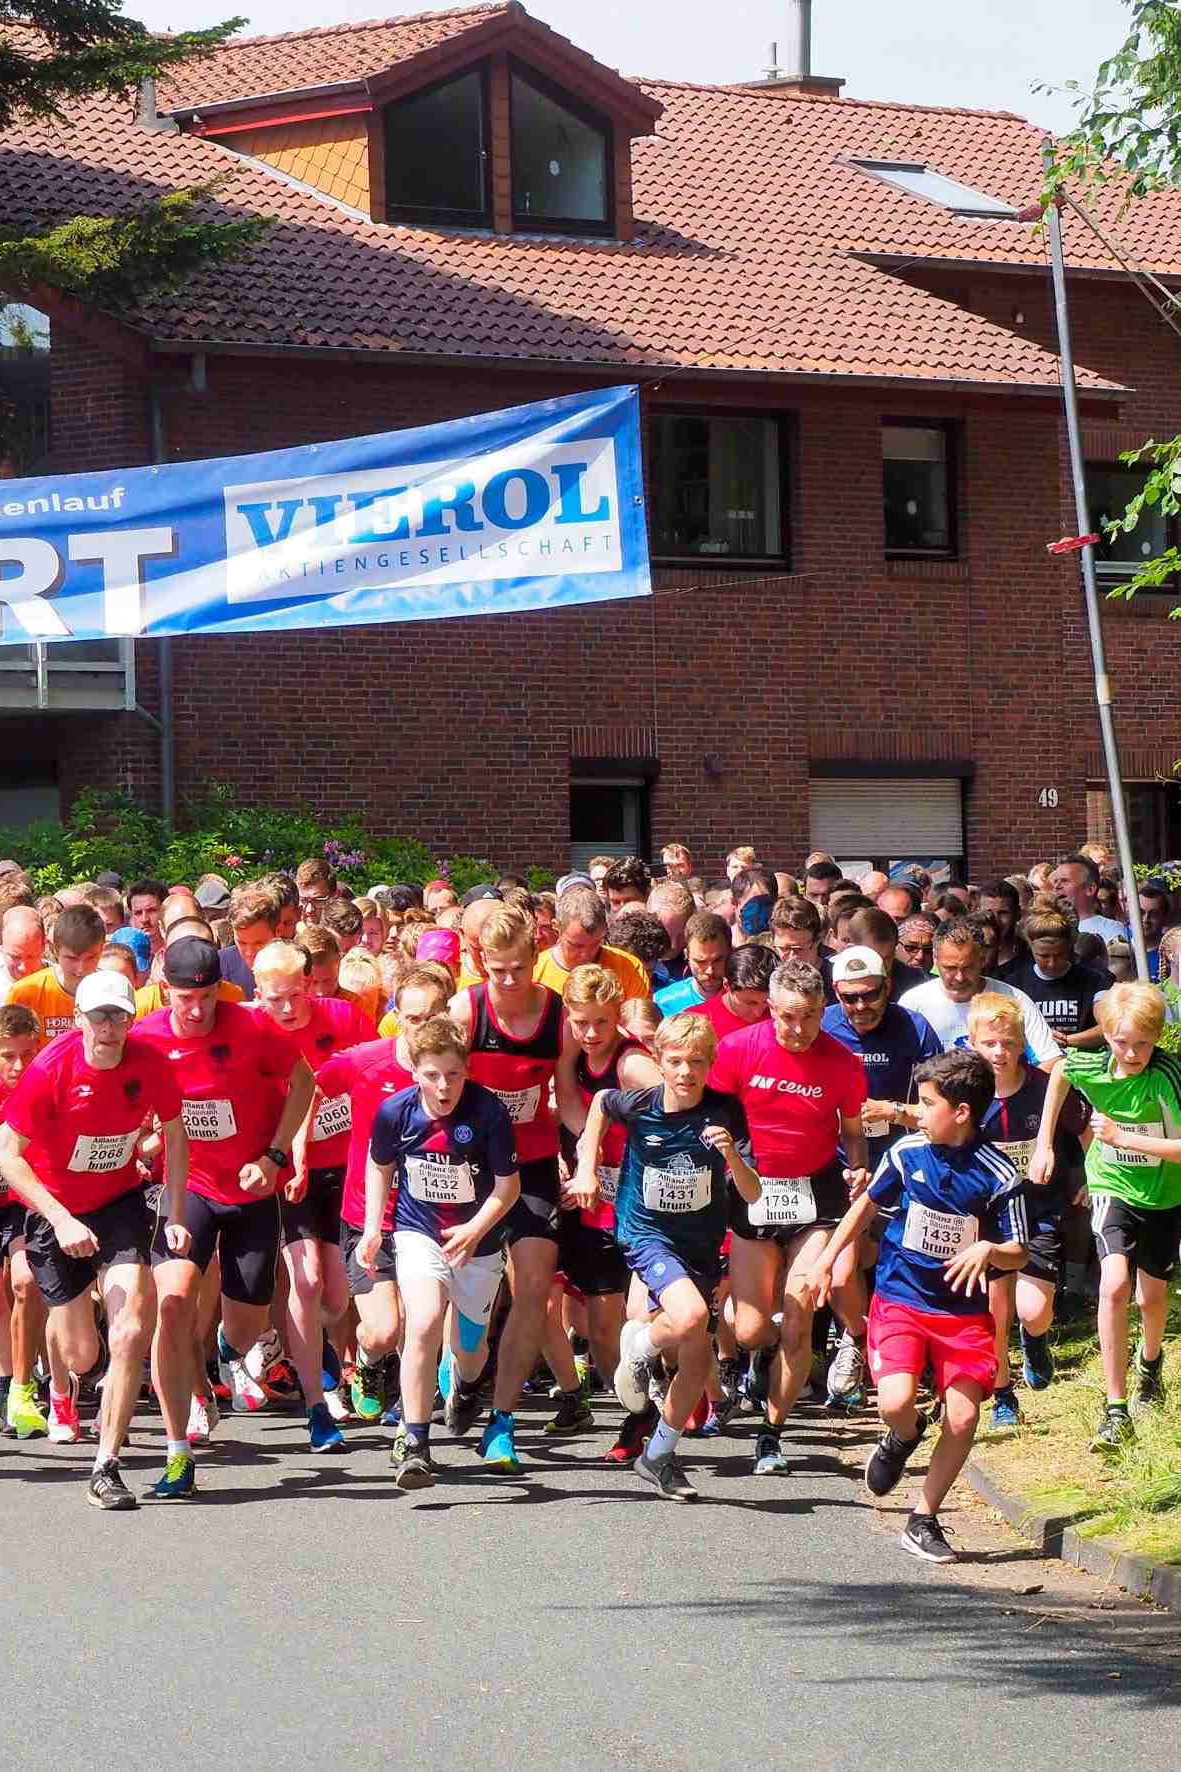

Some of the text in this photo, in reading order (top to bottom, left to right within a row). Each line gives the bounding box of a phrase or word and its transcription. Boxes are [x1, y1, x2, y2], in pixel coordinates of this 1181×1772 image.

[235, 462, 610, 553] VIEROL
[258, 533, 614, 582] AKTIENGESELLSCHAFT
[1038, 788, 1059, 807] 49
[777, 1079, 823, 1098] cewe
[183, 1115, 219, 1127] 2066
[317, 1104, 350, 1126] 2060
[89, 1147, 124, 1160] 2068
[1115, 1149, 1148, 1163] bruns
[88, 1160, 118, 1170] bruns
[421, 1176, 459, 1190] 1432
[425, 1187, 458, 1200] bruns
[659, 1187, 694, 1200] 1431
[764, 1194, 799, 1207] 1794
[659, 1199, 692, 1210] bruns
[766, 1208, 798, 1221] bruns
[923, 1209, 952, 1224] Allianz
[922, 1225, 962, 1245] 1433
[922, 1238, 957, 1256] bruns
